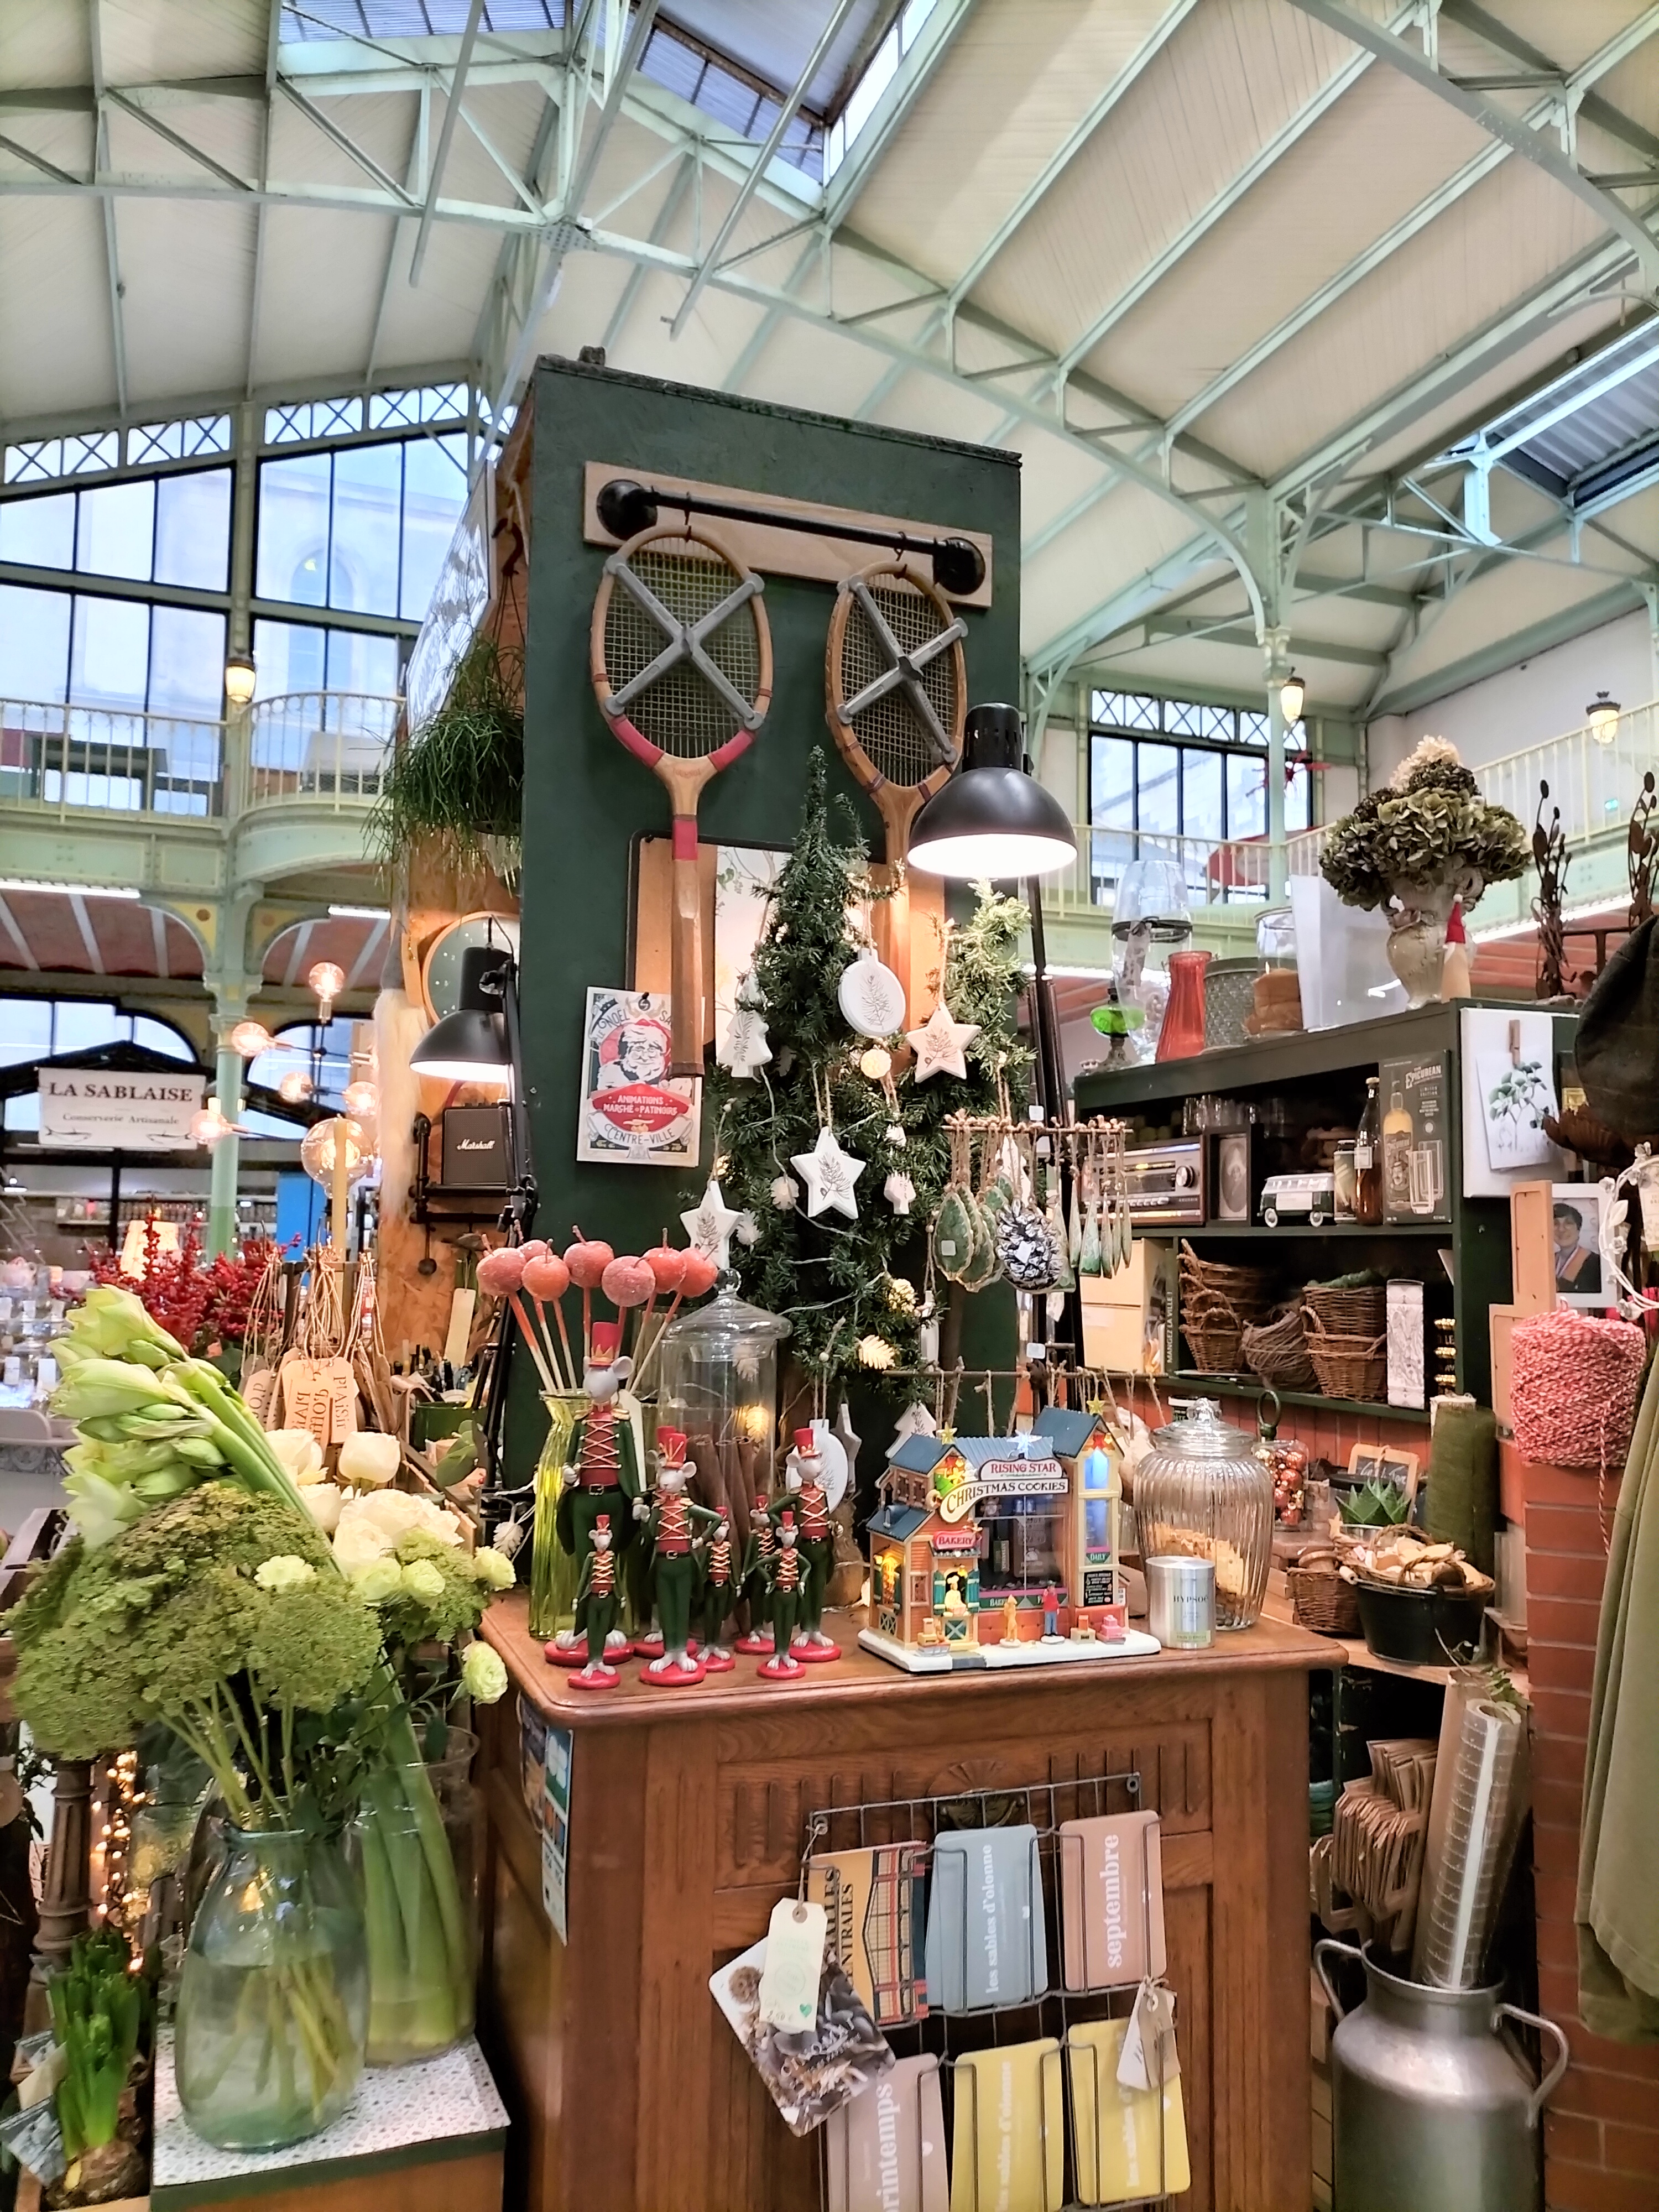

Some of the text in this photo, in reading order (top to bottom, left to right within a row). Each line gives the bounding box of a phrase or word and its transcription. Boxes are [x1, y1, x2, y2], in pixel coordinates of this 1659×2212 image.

[598, 1008, 631, 1030] NOËL
[1405, 1065, 1442, 1089] EPICUREAN
[49, 1082, 192, 1102] LA SABLAISE
[617, 1095, 664, 1104] ANIMATIONS
[63, 1113, 180, 1124] Conserverie Artisanale
[639, 1106, 677, 1115] PATINOIRE
[456, 1138, 495, 1151] Marshall
[604, 1123, 676, 1145] CENTRE-VILLE
[1167, 1318, 1173, 1327] LA
[990, 1463, 1056, 1474] RISING STAR
[946, 1481, 1066, 1514] CHRISTMAS COOKIES
[940, 1536, 973, 1545] BAKERY
[1090, 1553, 1106, 1561] DAILY
[1099, 1834, 1126, 1969] septembre
[984, 1916, 998, 1966] sables
[985, 1969, 999, 1994] les
[876, 2083, 901, 2212] rintemps
[997, 2135, 1011, 2187] sables
